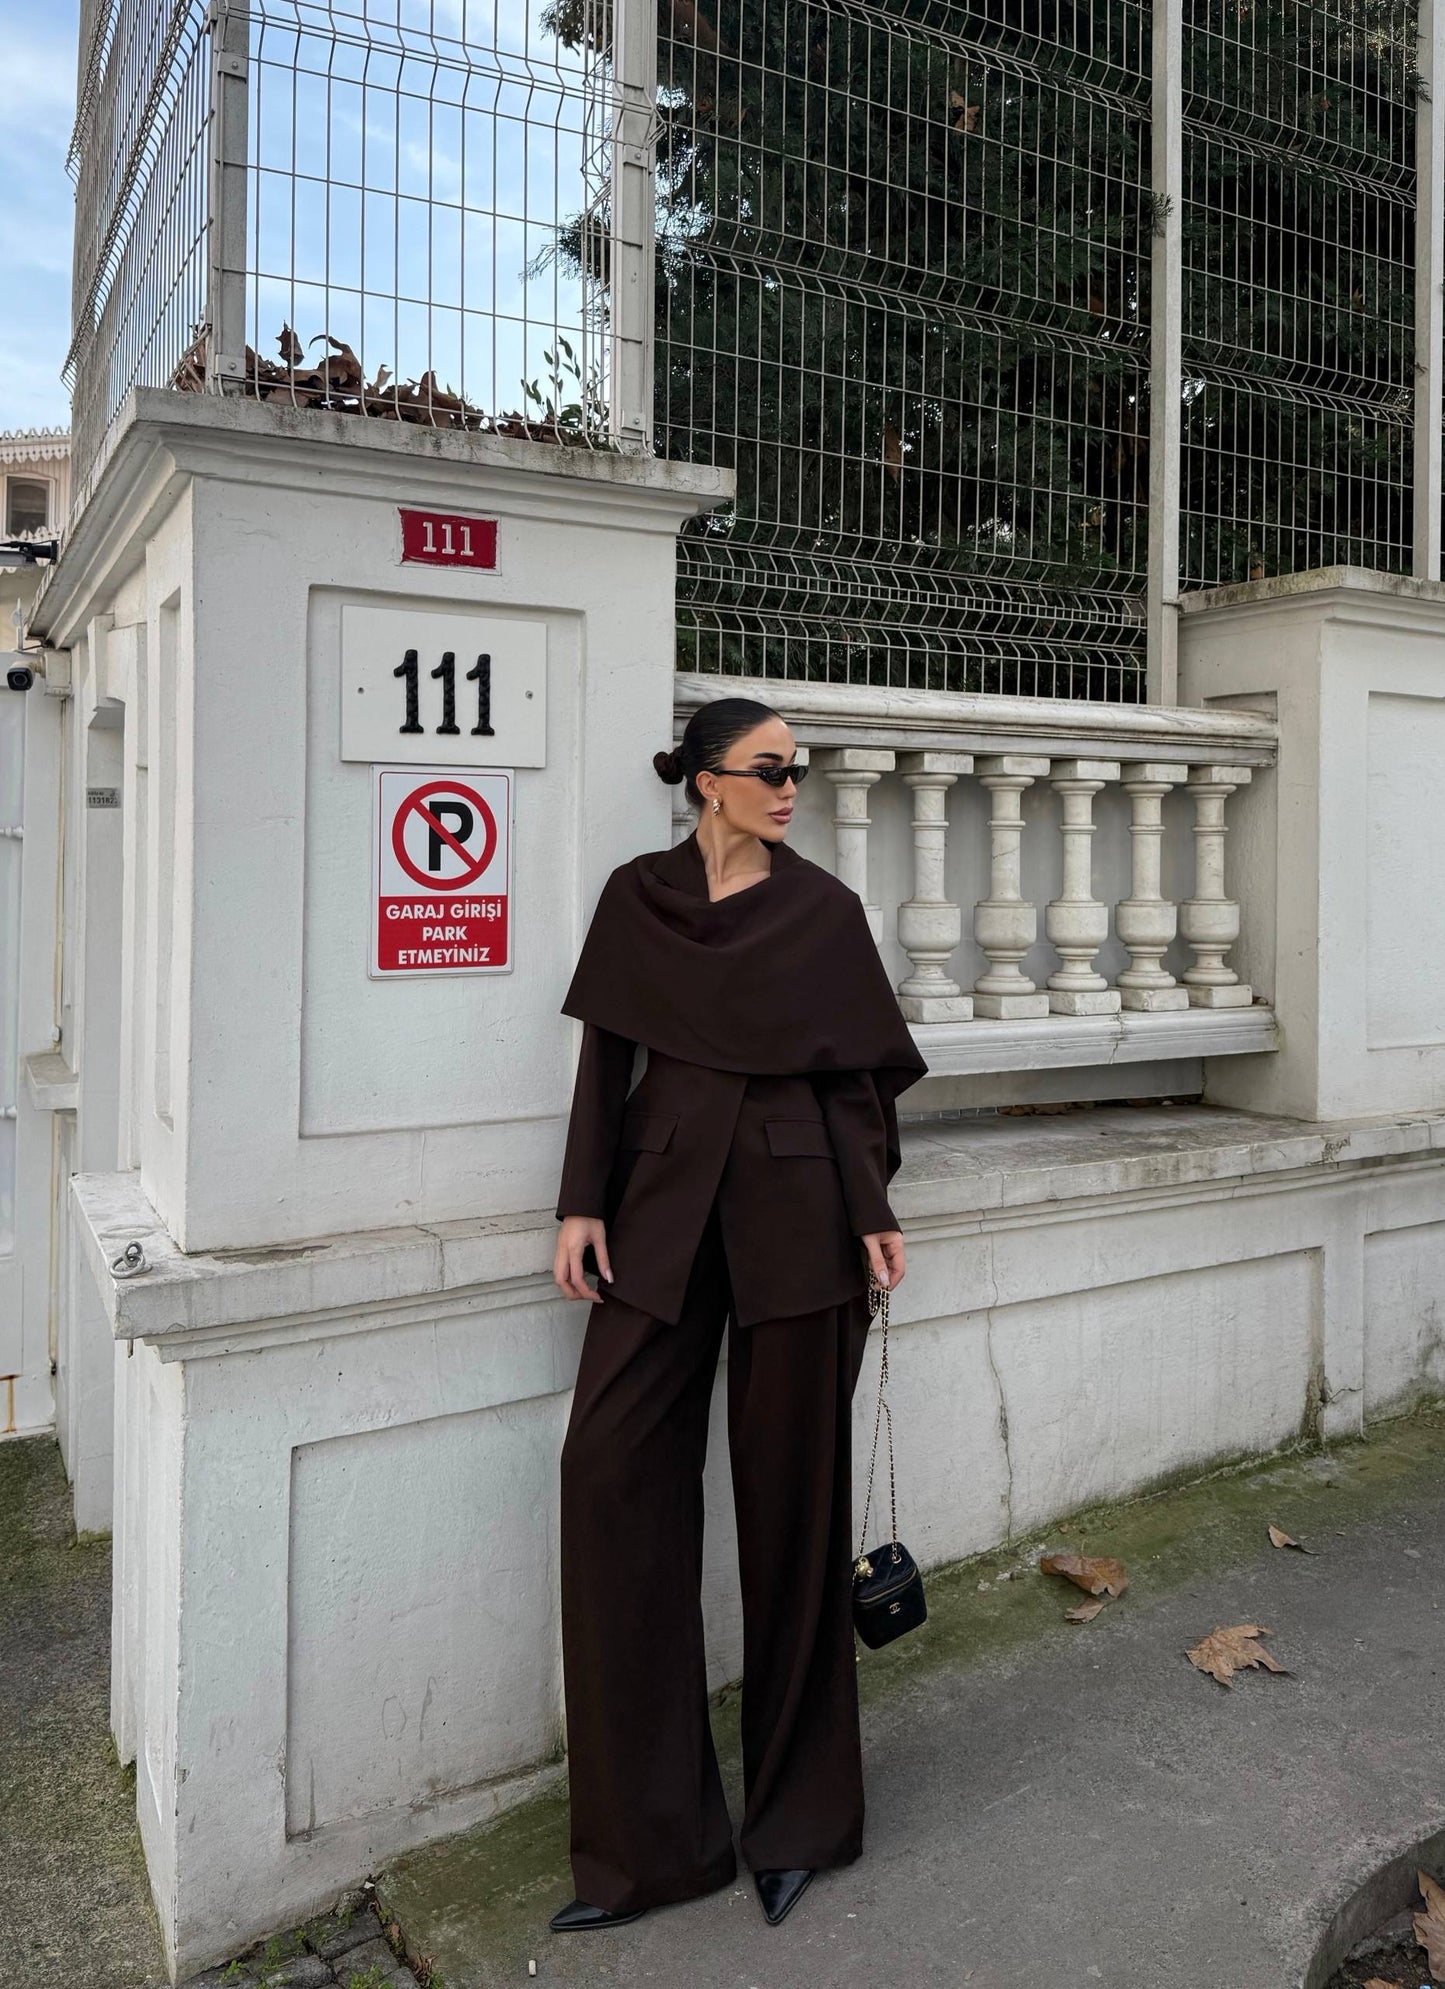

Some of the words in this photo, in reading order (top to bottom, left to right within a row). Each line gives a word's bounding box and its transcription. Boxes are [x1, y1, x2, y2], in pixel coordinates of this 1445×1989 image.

[423, 521, 475, 557] 111
[393, 649, 497, 737] 111
[386, 904, 445, 920] GARAJ
[450, 899, 502, 922] GİRİŞİ
[422, 926, 468, 941] PARK
[398, 943, 491, 965] ETMEYİNİZ
